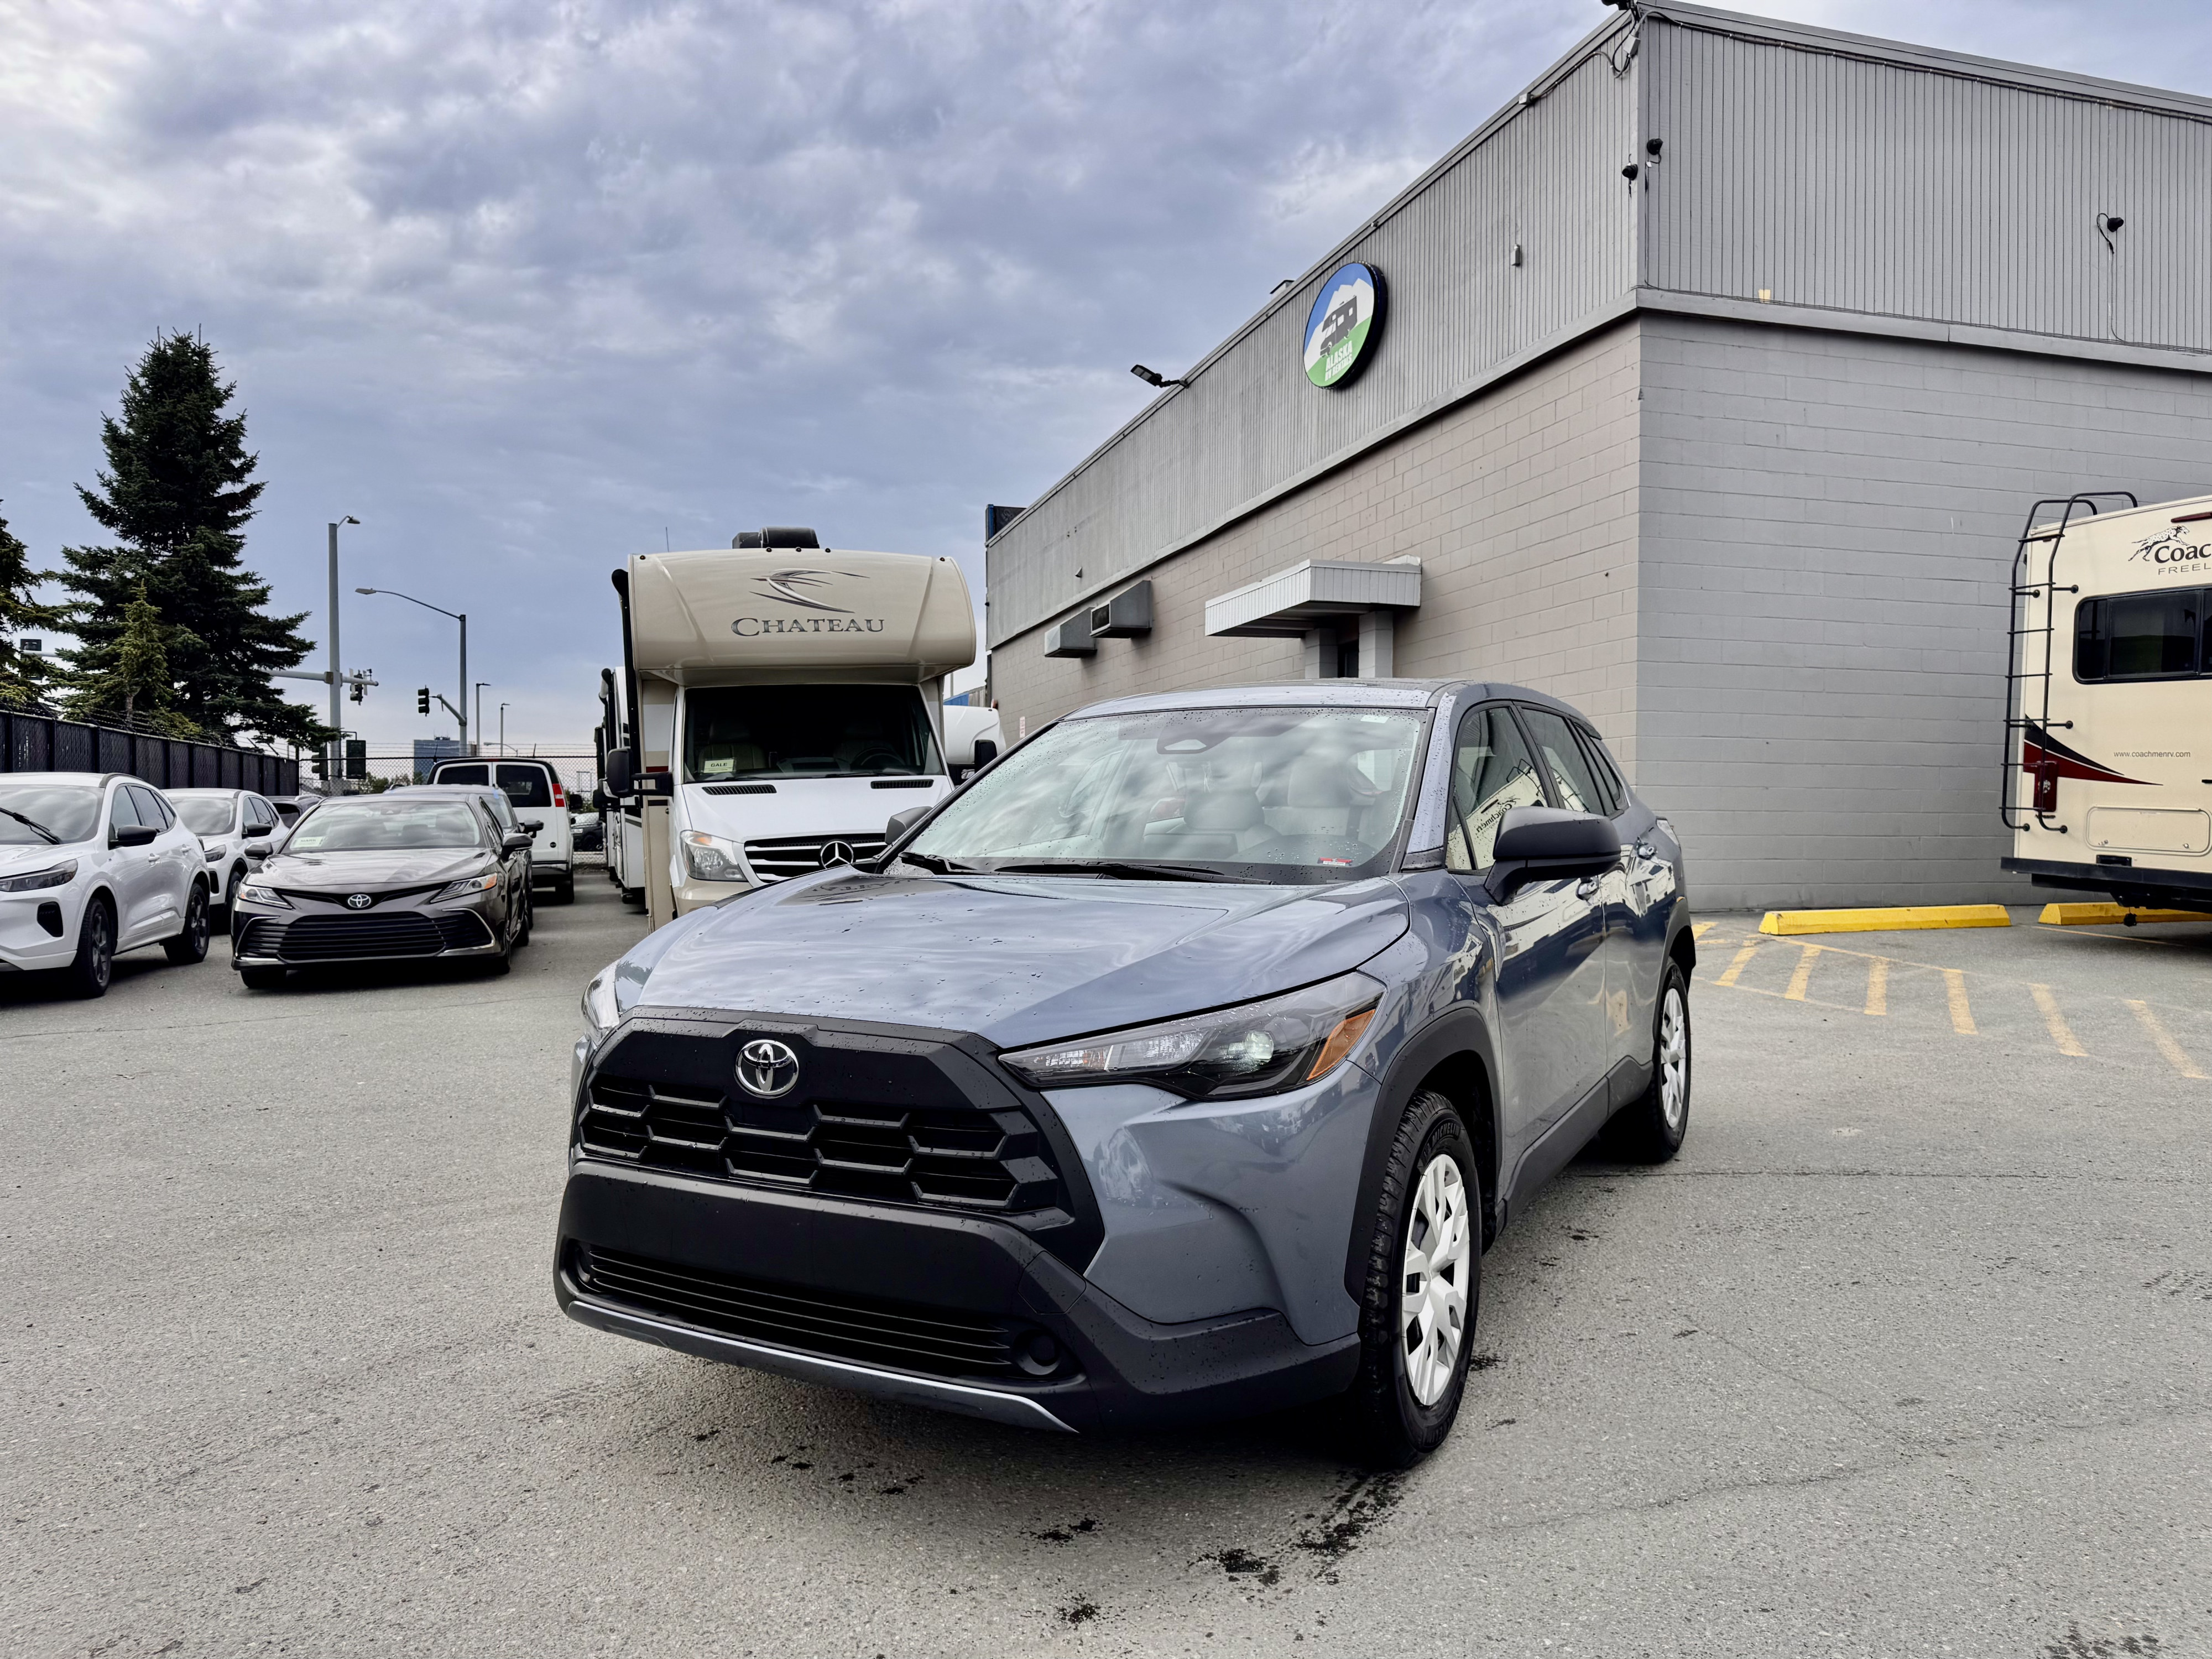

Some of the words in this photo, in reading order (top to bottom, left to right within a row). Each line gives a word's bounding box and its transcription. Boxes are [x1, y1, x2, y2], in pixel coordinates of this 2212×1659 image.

[1326, 340, 1353, 372] ALASKA
[1332, 354, 1353, 377] RENTALS
[2154, 544, 2212, 564] Coac
[2158, 563, 2212, 575] FREEL
[1432, 1122, 1460, 1147] MICHELIN
